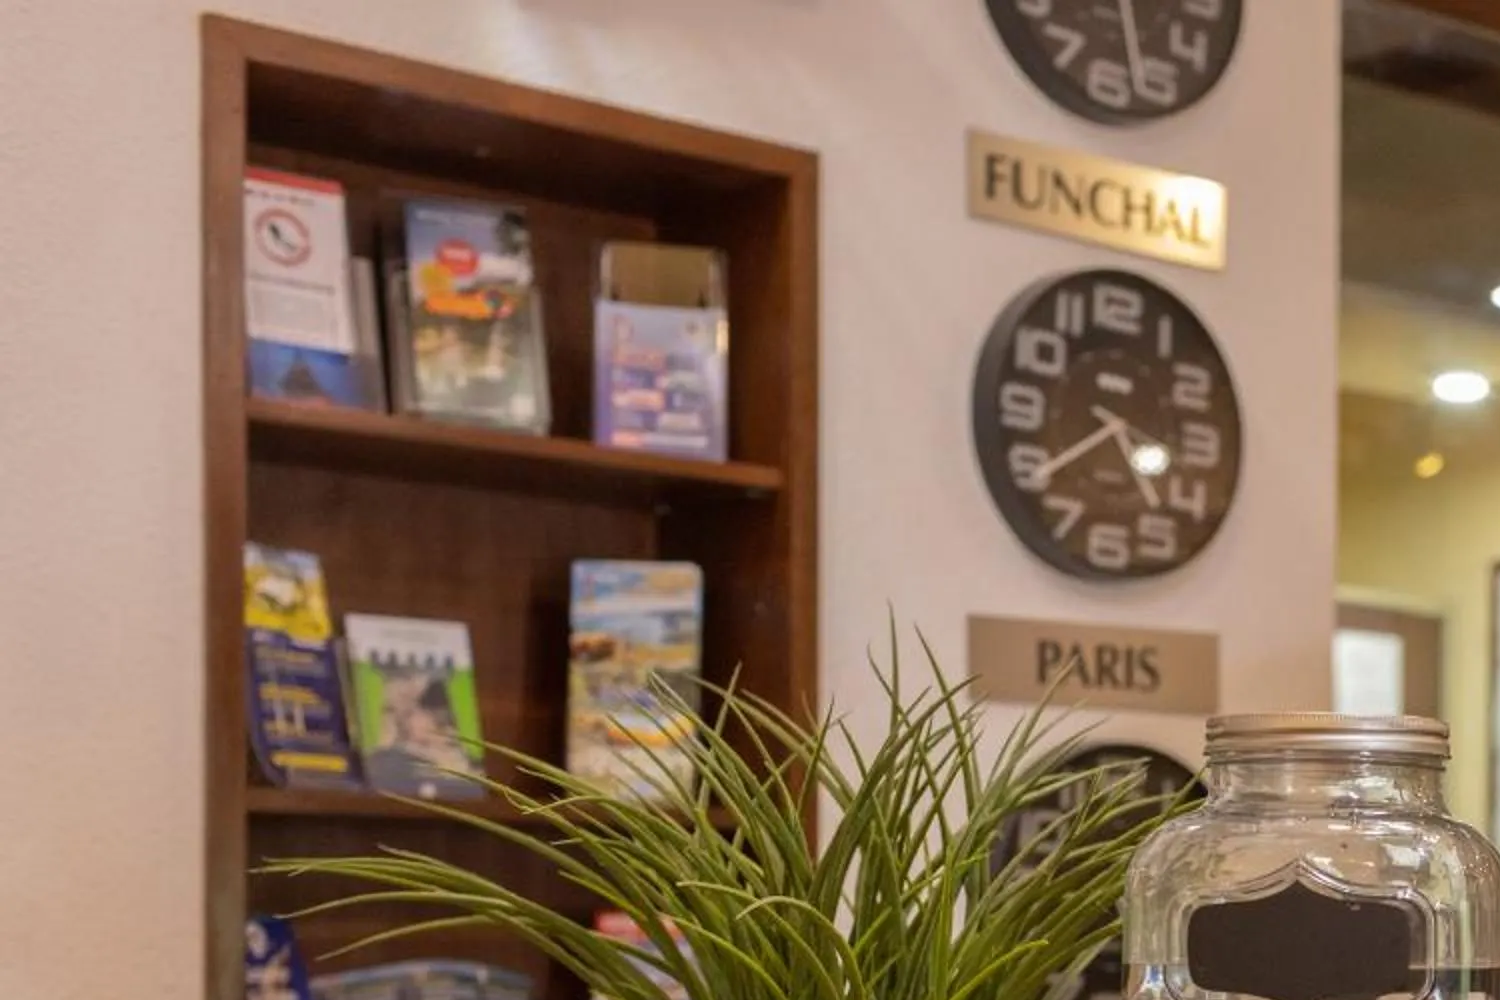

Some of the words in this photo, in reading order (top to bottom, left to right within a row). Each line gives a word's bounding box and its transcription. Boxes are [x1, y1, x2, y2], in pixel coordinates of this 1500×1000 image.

[1041, 22, 1087, 69] 7
[1168, 20, 1208, 73] 4
[1086, 57, 1132, 108] 6
[984, 152, 1211, 250] FUNCHAL
[1000, 380, 1046, 432] 9
[1171, 361, 1212, 412] 2
[1182, 421, 1221, 469] 3
[1042, 494, 1087, 541] 7
[1168, 475, 1208, 525] 4
[1086, 523, 1131, 571] 6
[1137, 514, 1178, 560] 5
[1036, 638, 1161, 694] PARIS
